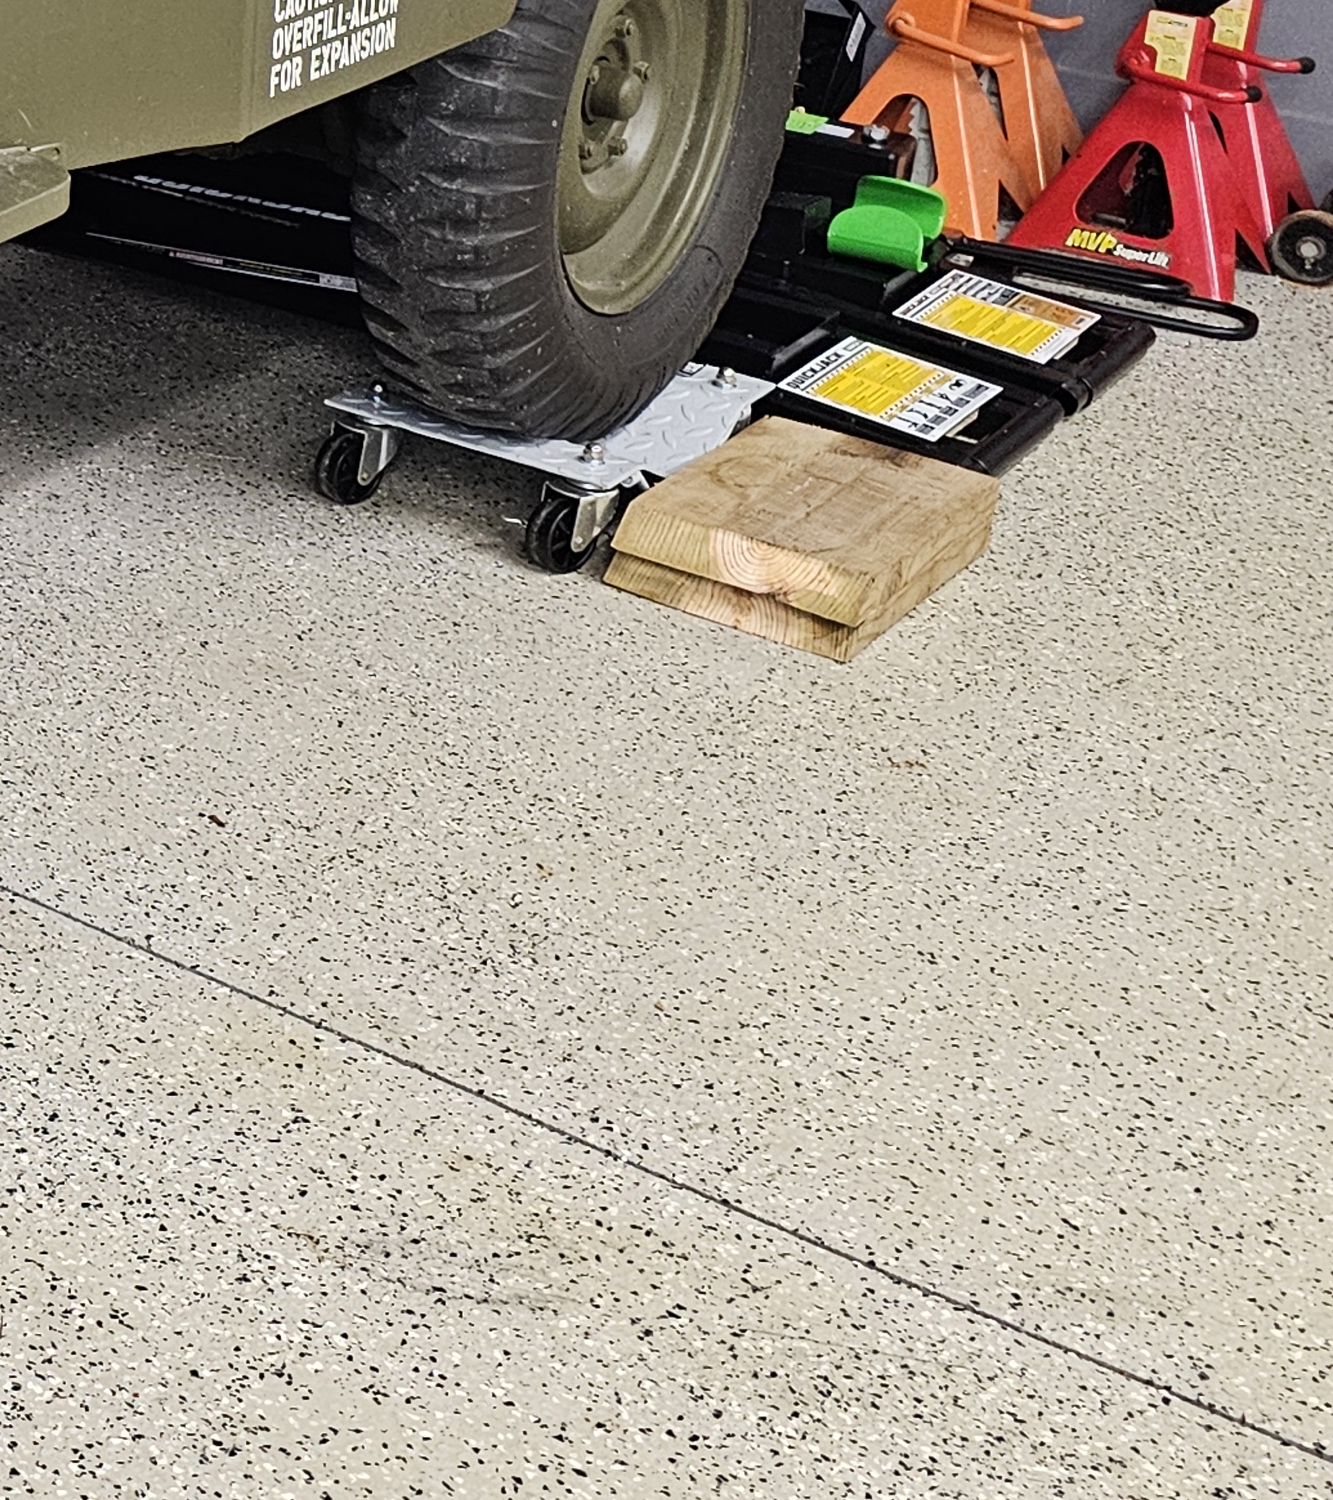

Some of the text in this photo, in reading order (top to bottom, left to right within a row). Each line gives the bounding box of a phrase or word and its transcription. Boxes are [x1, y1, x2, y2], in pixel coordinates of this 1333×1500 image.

[269, 17, 397, 98] FOR EXPANSION
[1065, 228, 1118, 253] MVP
